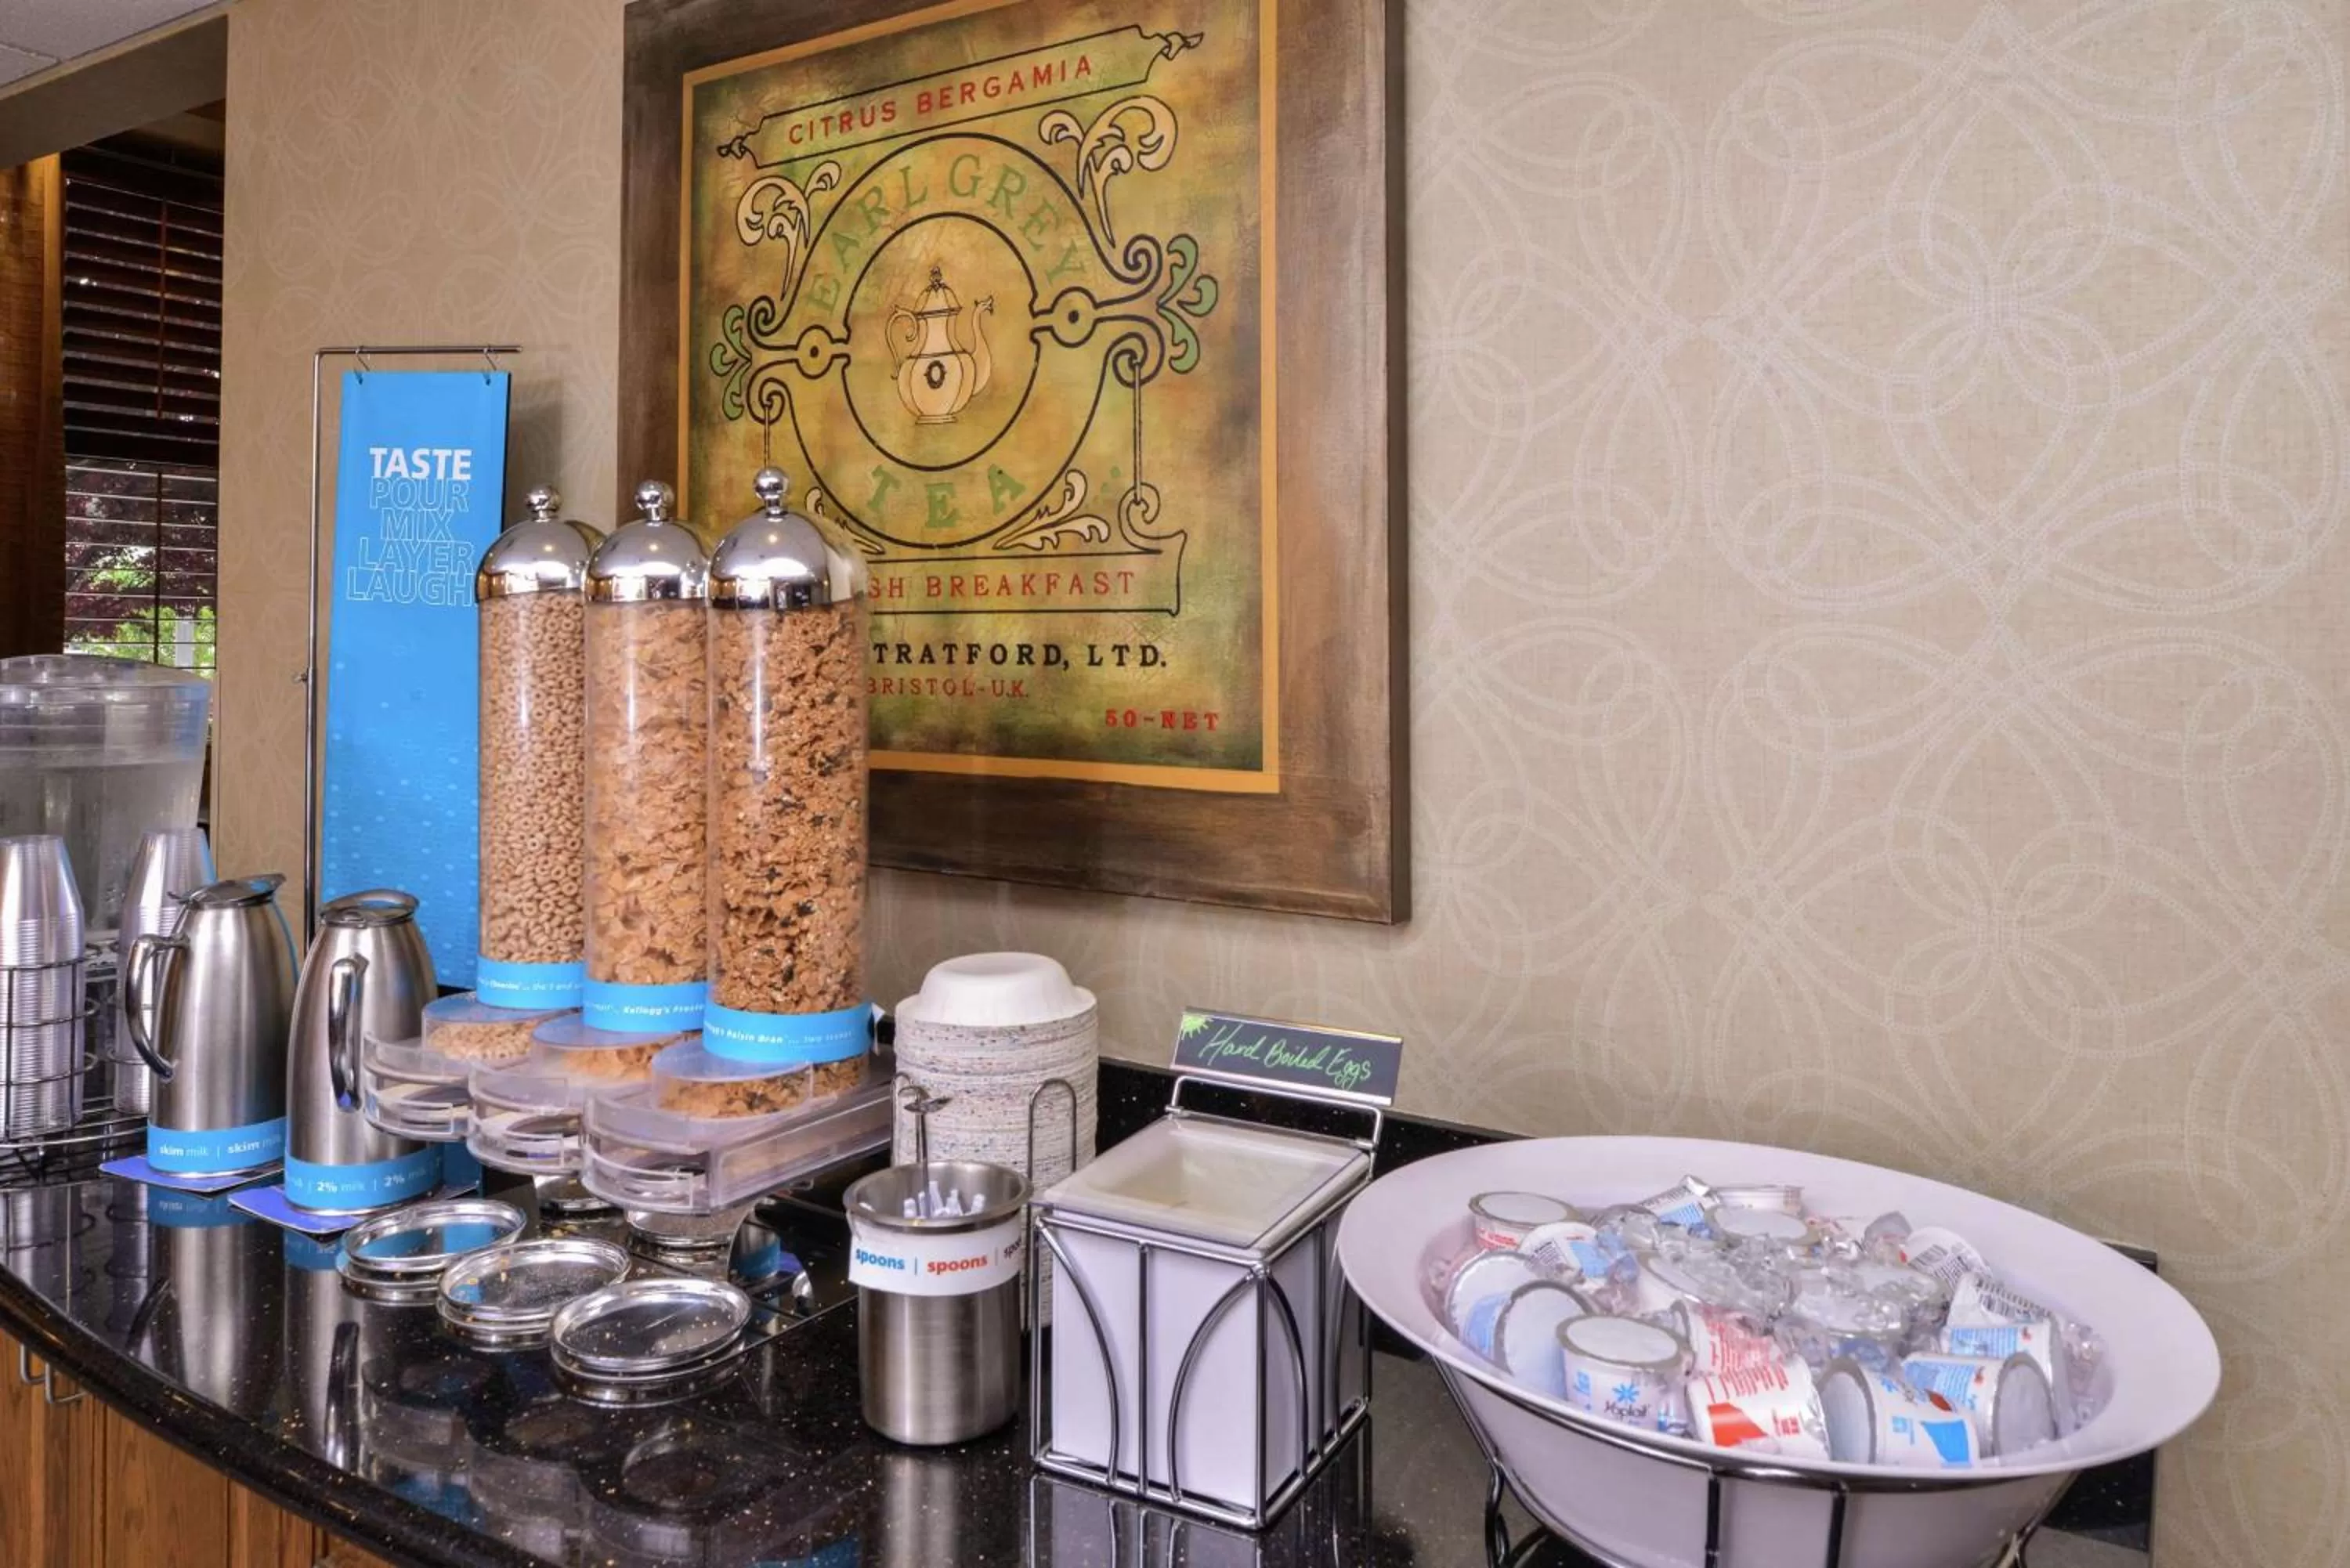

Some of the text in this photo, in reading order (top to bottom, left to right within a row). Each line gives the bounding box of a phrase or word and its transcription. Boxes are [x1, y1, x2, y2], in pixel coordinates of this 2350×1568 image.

[788, 55, 1092, 145] CITRUS BERGAMIA
[806, 153, 1086, 313] EARL GREY
[369, 447, 472, 480] TASTE
[369, 476, 469, 512] POUR
[866, 464, 1025, 529] TEA
[380, 508, 454, 541] MIX
[358, 537, 475, 574] LAYER
[925, 571, 1136, 598] BREAKFAST
[873, 642, 1166, 671] TRATFORD, LTD.
[1263, 1038, 1329, 1070] Boiled
[1325, 1048, 1371, 1091] Eggs
[159, 1143, 183, 1157] skim
[228, 1141, 260, 1154] skim
[316, 1181, 338, 1192] 2%
[383, 1175, 406, 1187] 2%
[855, 1248, 905, 1270] spoons
[927, 1255, 988, 1275] spoons
